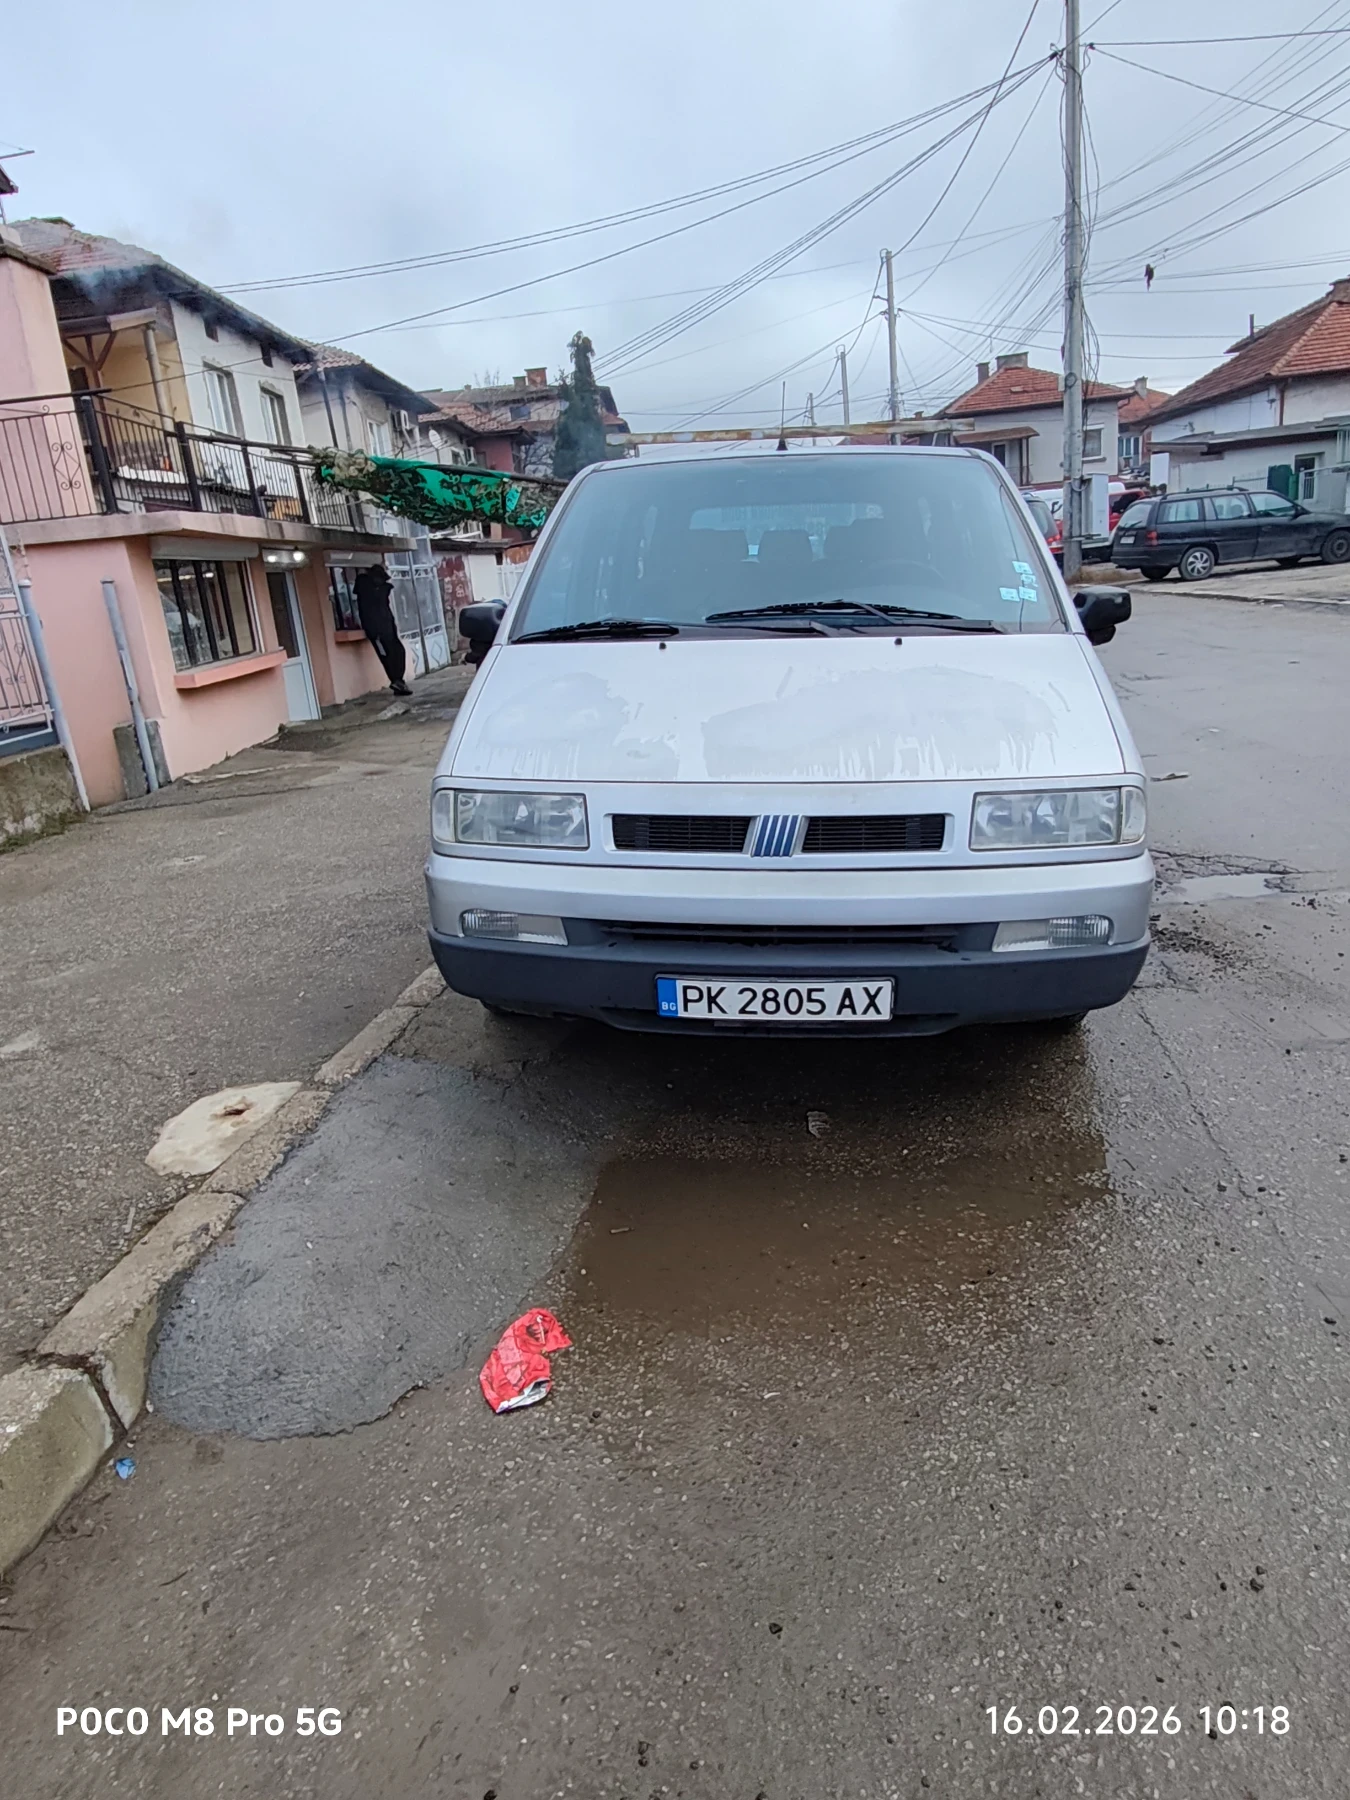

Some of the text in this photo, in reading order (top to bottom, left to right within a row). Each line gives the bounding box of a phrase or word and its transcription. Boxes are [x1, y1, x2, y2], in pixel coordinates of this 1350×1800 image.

[661, 1001, 676, 1011] BG
[682, 985, 884, 1016] PK 2805 AX
